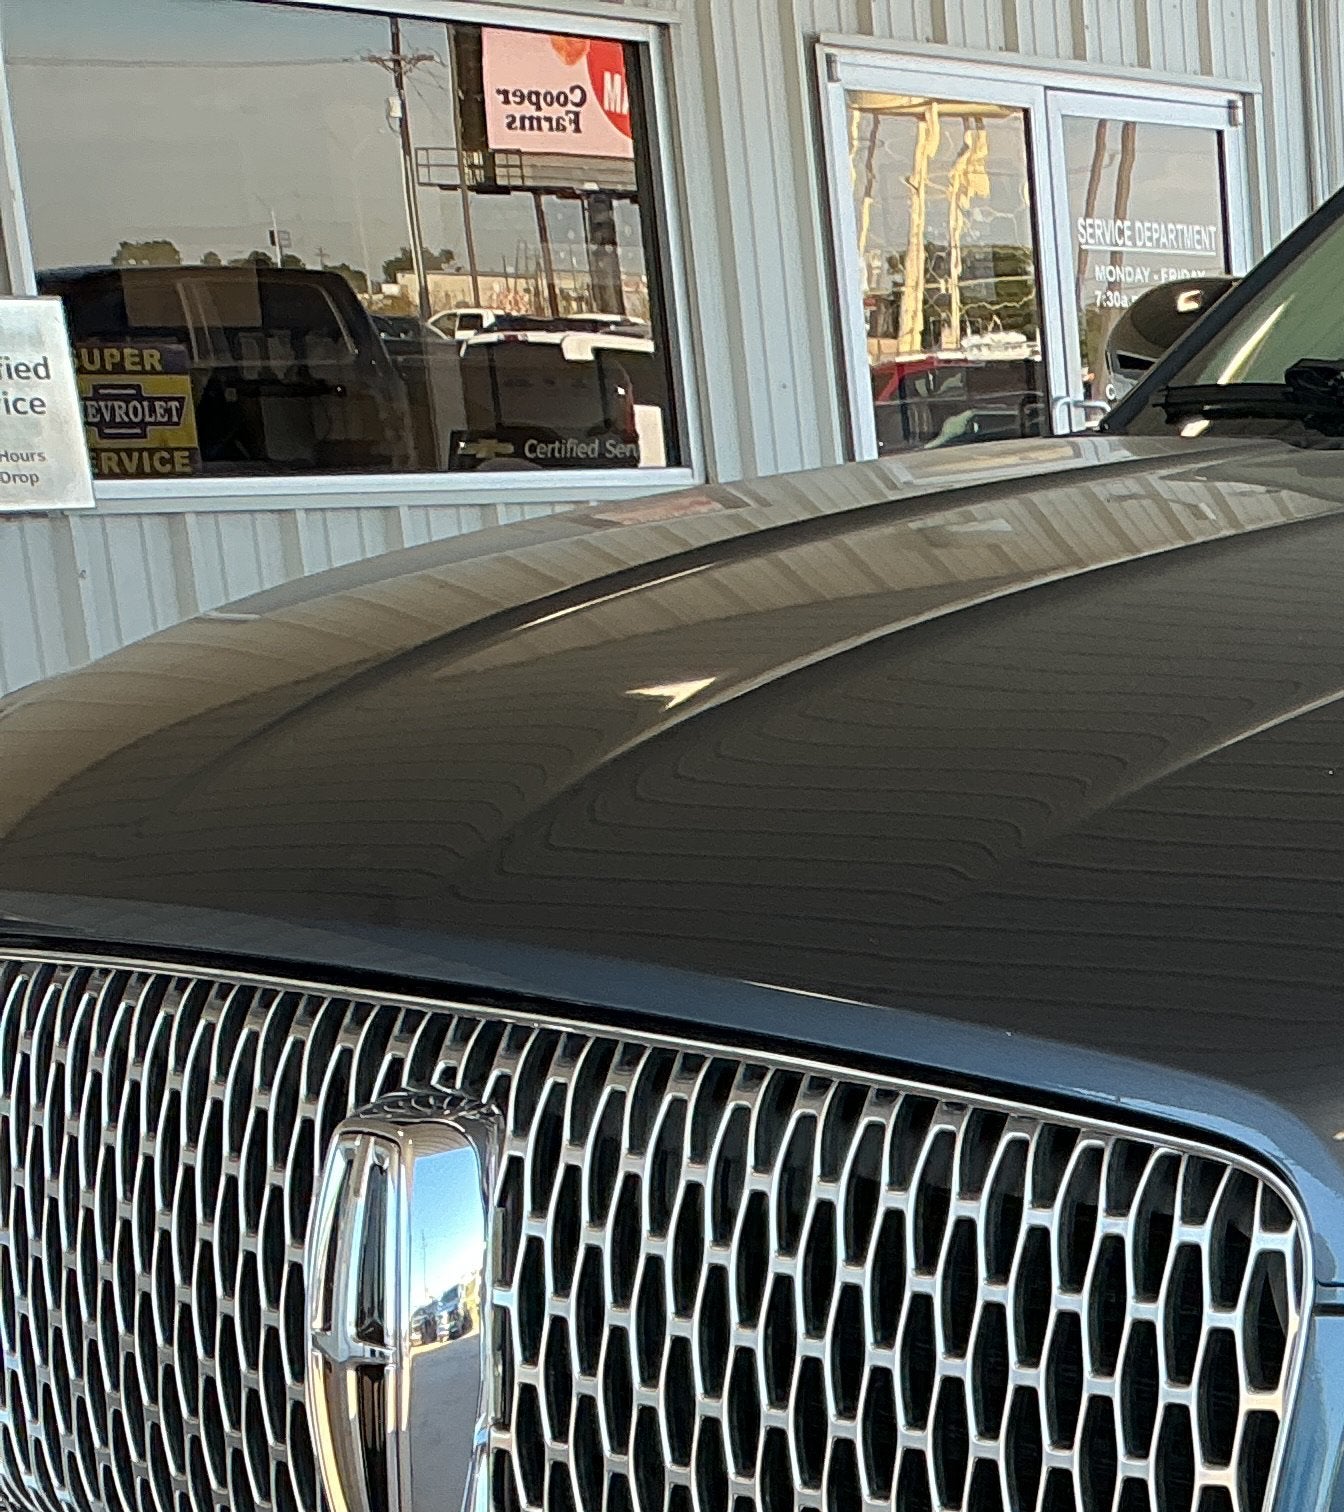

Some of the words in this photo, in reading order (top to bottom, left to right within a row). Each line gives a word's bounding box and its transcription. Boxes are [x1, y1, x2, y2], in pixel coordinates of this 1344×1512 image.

[1077, 217, 1132, 246] SERVICE
[1135, 220, 1217, 251] DEPARTMENT
[1094, 264, 1150, 283] MONDAY
[0, 355, 51, 380] ied
[73, 347, 163, 372] UPER
[84, 399, 180, 423] EVROLET
[524, 438, 599, 459] Certified
[90, 450, 192, 474] RVICE
